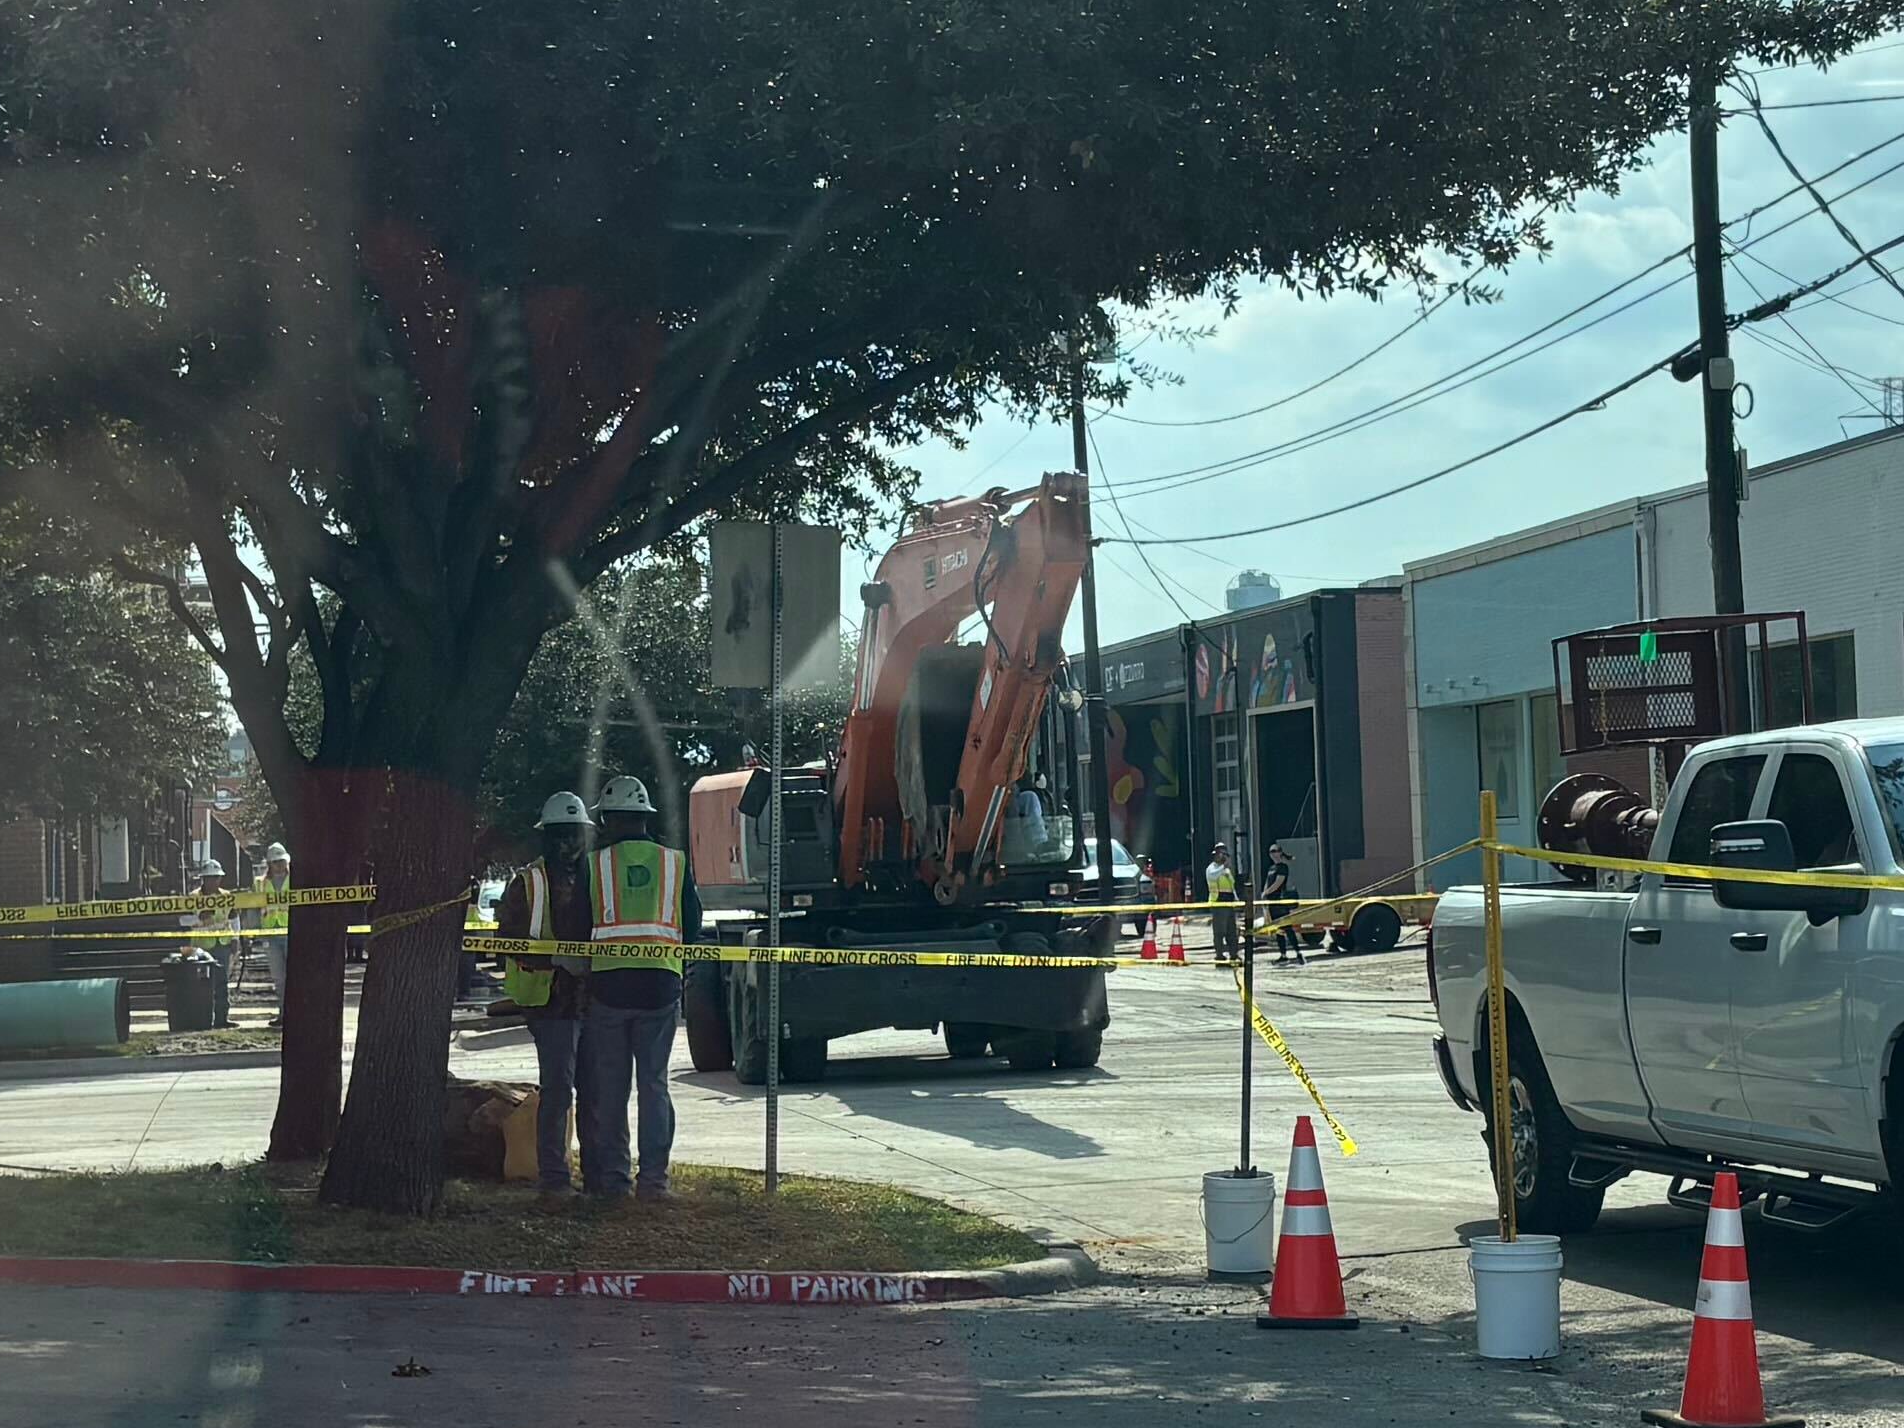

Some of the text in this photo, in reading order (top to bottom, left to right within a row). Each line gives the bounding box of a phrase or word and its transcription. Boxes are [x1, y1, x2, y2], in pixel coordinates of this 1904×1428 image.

[484, 940, 530, 952] CROSS
[557, 943, 721, 960] FIRE LINE DO NOT CROSS
[749, 948, 918, 964] FIRE LINE DO NOT CROSS
[1255, 1015, 1279, 1044] FIRE
[728, 1273, 927, 1302] NO PARKING
